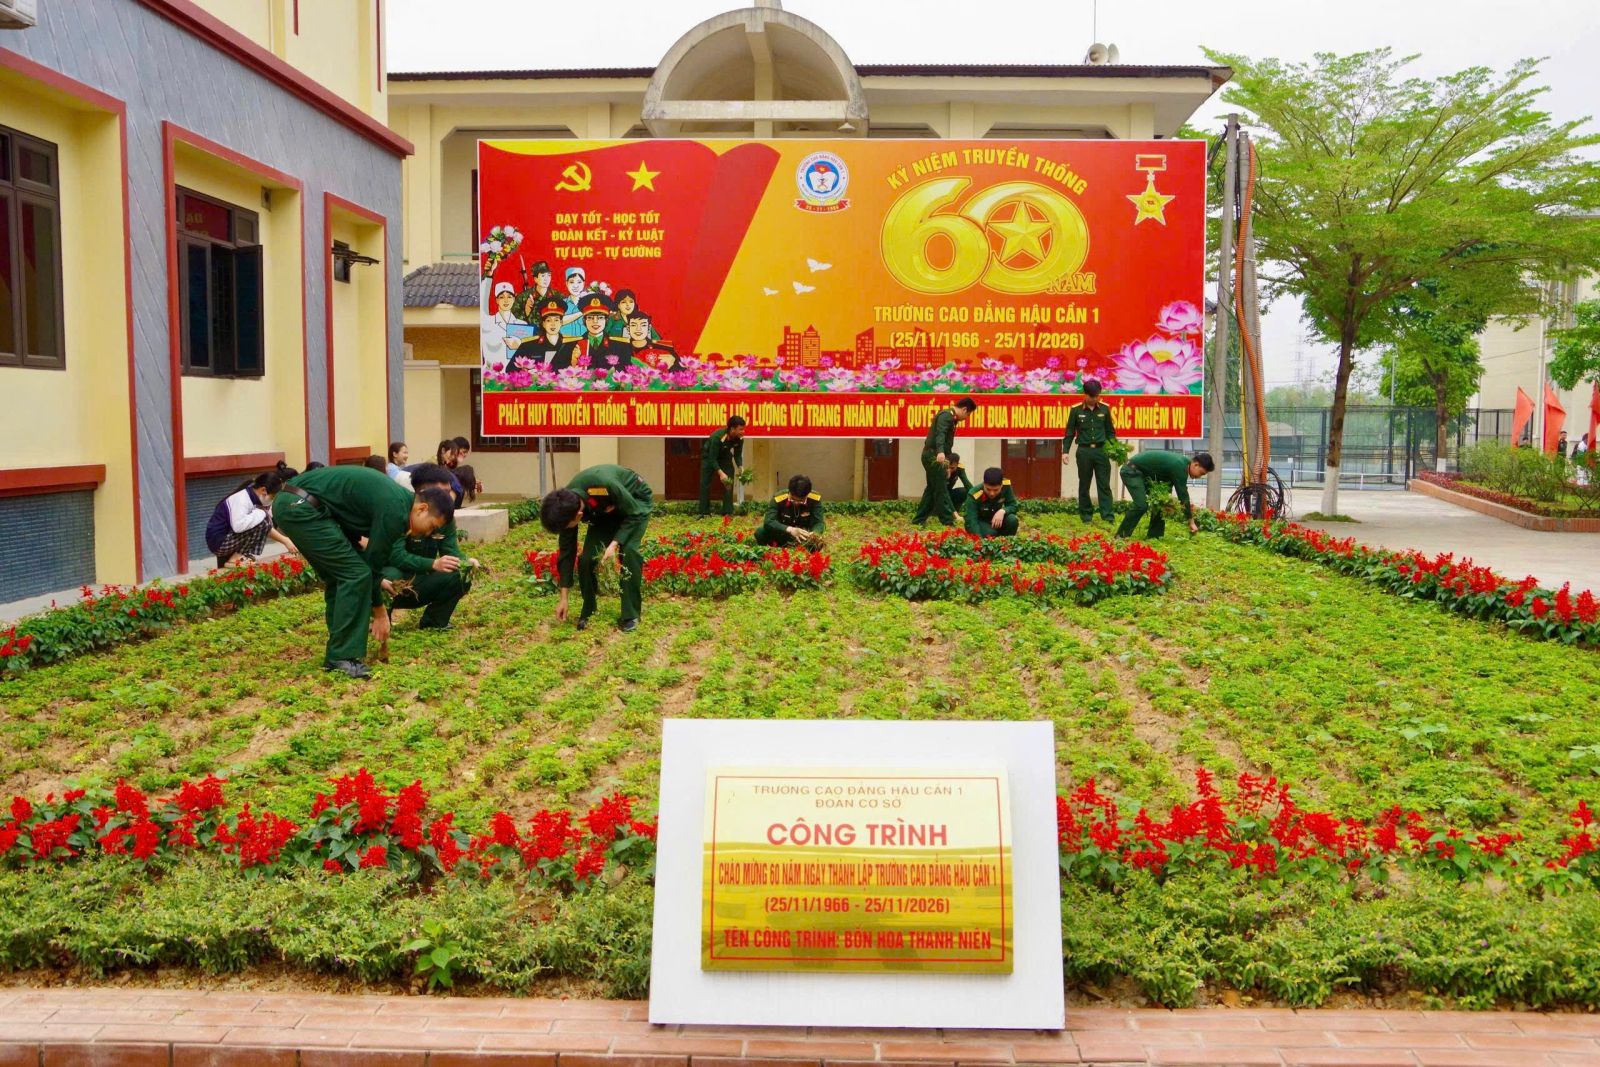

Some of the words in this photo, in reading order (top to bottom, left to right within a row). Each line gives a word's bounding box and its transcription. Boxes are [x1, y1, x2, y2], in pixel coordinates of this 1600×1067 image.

[886, 164, 910, 190] KỶ
[912, 152, 958, 177] NIỆM
[963, 146, 1030, 168] TRUYỀN
[1034, 157, 1088, 196] THỐNG
[556, 213, 578, 226] DẠY
[582, 210, 602, 224] TỐT
[613, 213, 636, 226] HỌC
[640, 210, 660, 224] TỐT
[551, 228, 583, 241] ĐOÀN
[586, 227, 607, 241] KẾT
[618, 227, 633, 241] KỶ
[636, 228, 664, 242] LUẬT
[880, 175, 1090, 296] 60
[555, 246, 570, 260] TỰ
[571, 246, 593, 260] LỰC
[605, 246, 620, 260] TỰ
[622, 245, 662, 258] CƯỜNG
[874, 303, 934, 322] TRƯỜNG
[939, 306, 969, 322] CAO
[973, 300, 1015, 323] ĐẲNG
[1020, 304, 1050, 326] HẬU
[1055, 302, 1087, 323] CẦN
[1092, 308, 1099, 323] 1
[890, 331, 979, 349] (25/11/1966
[995, 332, 1084, 350] 25/11/2026)
[499, 399, 525, 426] PHÁT
[527, 403, 548, 426] HUY
[550, 396, 591, 426] TRUYỀN
[593, 396, 627, 426] THỐNG
[660, 403, 671, 430] VỊ
[673, 403, 696, 426] ANH
[698, 399, 726, 426] HÙNG
[752, 402, 788, 431] LƯỢNG
[790, 400, 803, 427] VŨ
[806, 404, 840, 427] TRANG
[843, 401, 876, 427] NHÂN
[988, 406, 1010, 428] ĐUA
[1011, 401, 1041, 428] HOÀN
[1135, 402, 1169, 434] NHIỆM
[1172, 407, 1186, 434] VỤ
[815, 786, 843, 795] CAO
[958, 787, 962, 795] 1
[767, 817, 856, 846] CÔNG
[866, 817, 948, 846] TRÌNH
[770, 863, 779, 885] 60
[910, 864, 926, 886] CAO
[993, 865, 997, 886] 1
[765, 897, 850, 912] (25/11/1966
[865, 898, 950, 914] 25/11/2026)
[724, 926, 749, 948] TÊN
[754, 926, 791, 948] CÔNG
[877, 931, 904, 948] HOA
[909, 931, 954, 948] THANH
[958, 928, 991, 949] NIÊN
